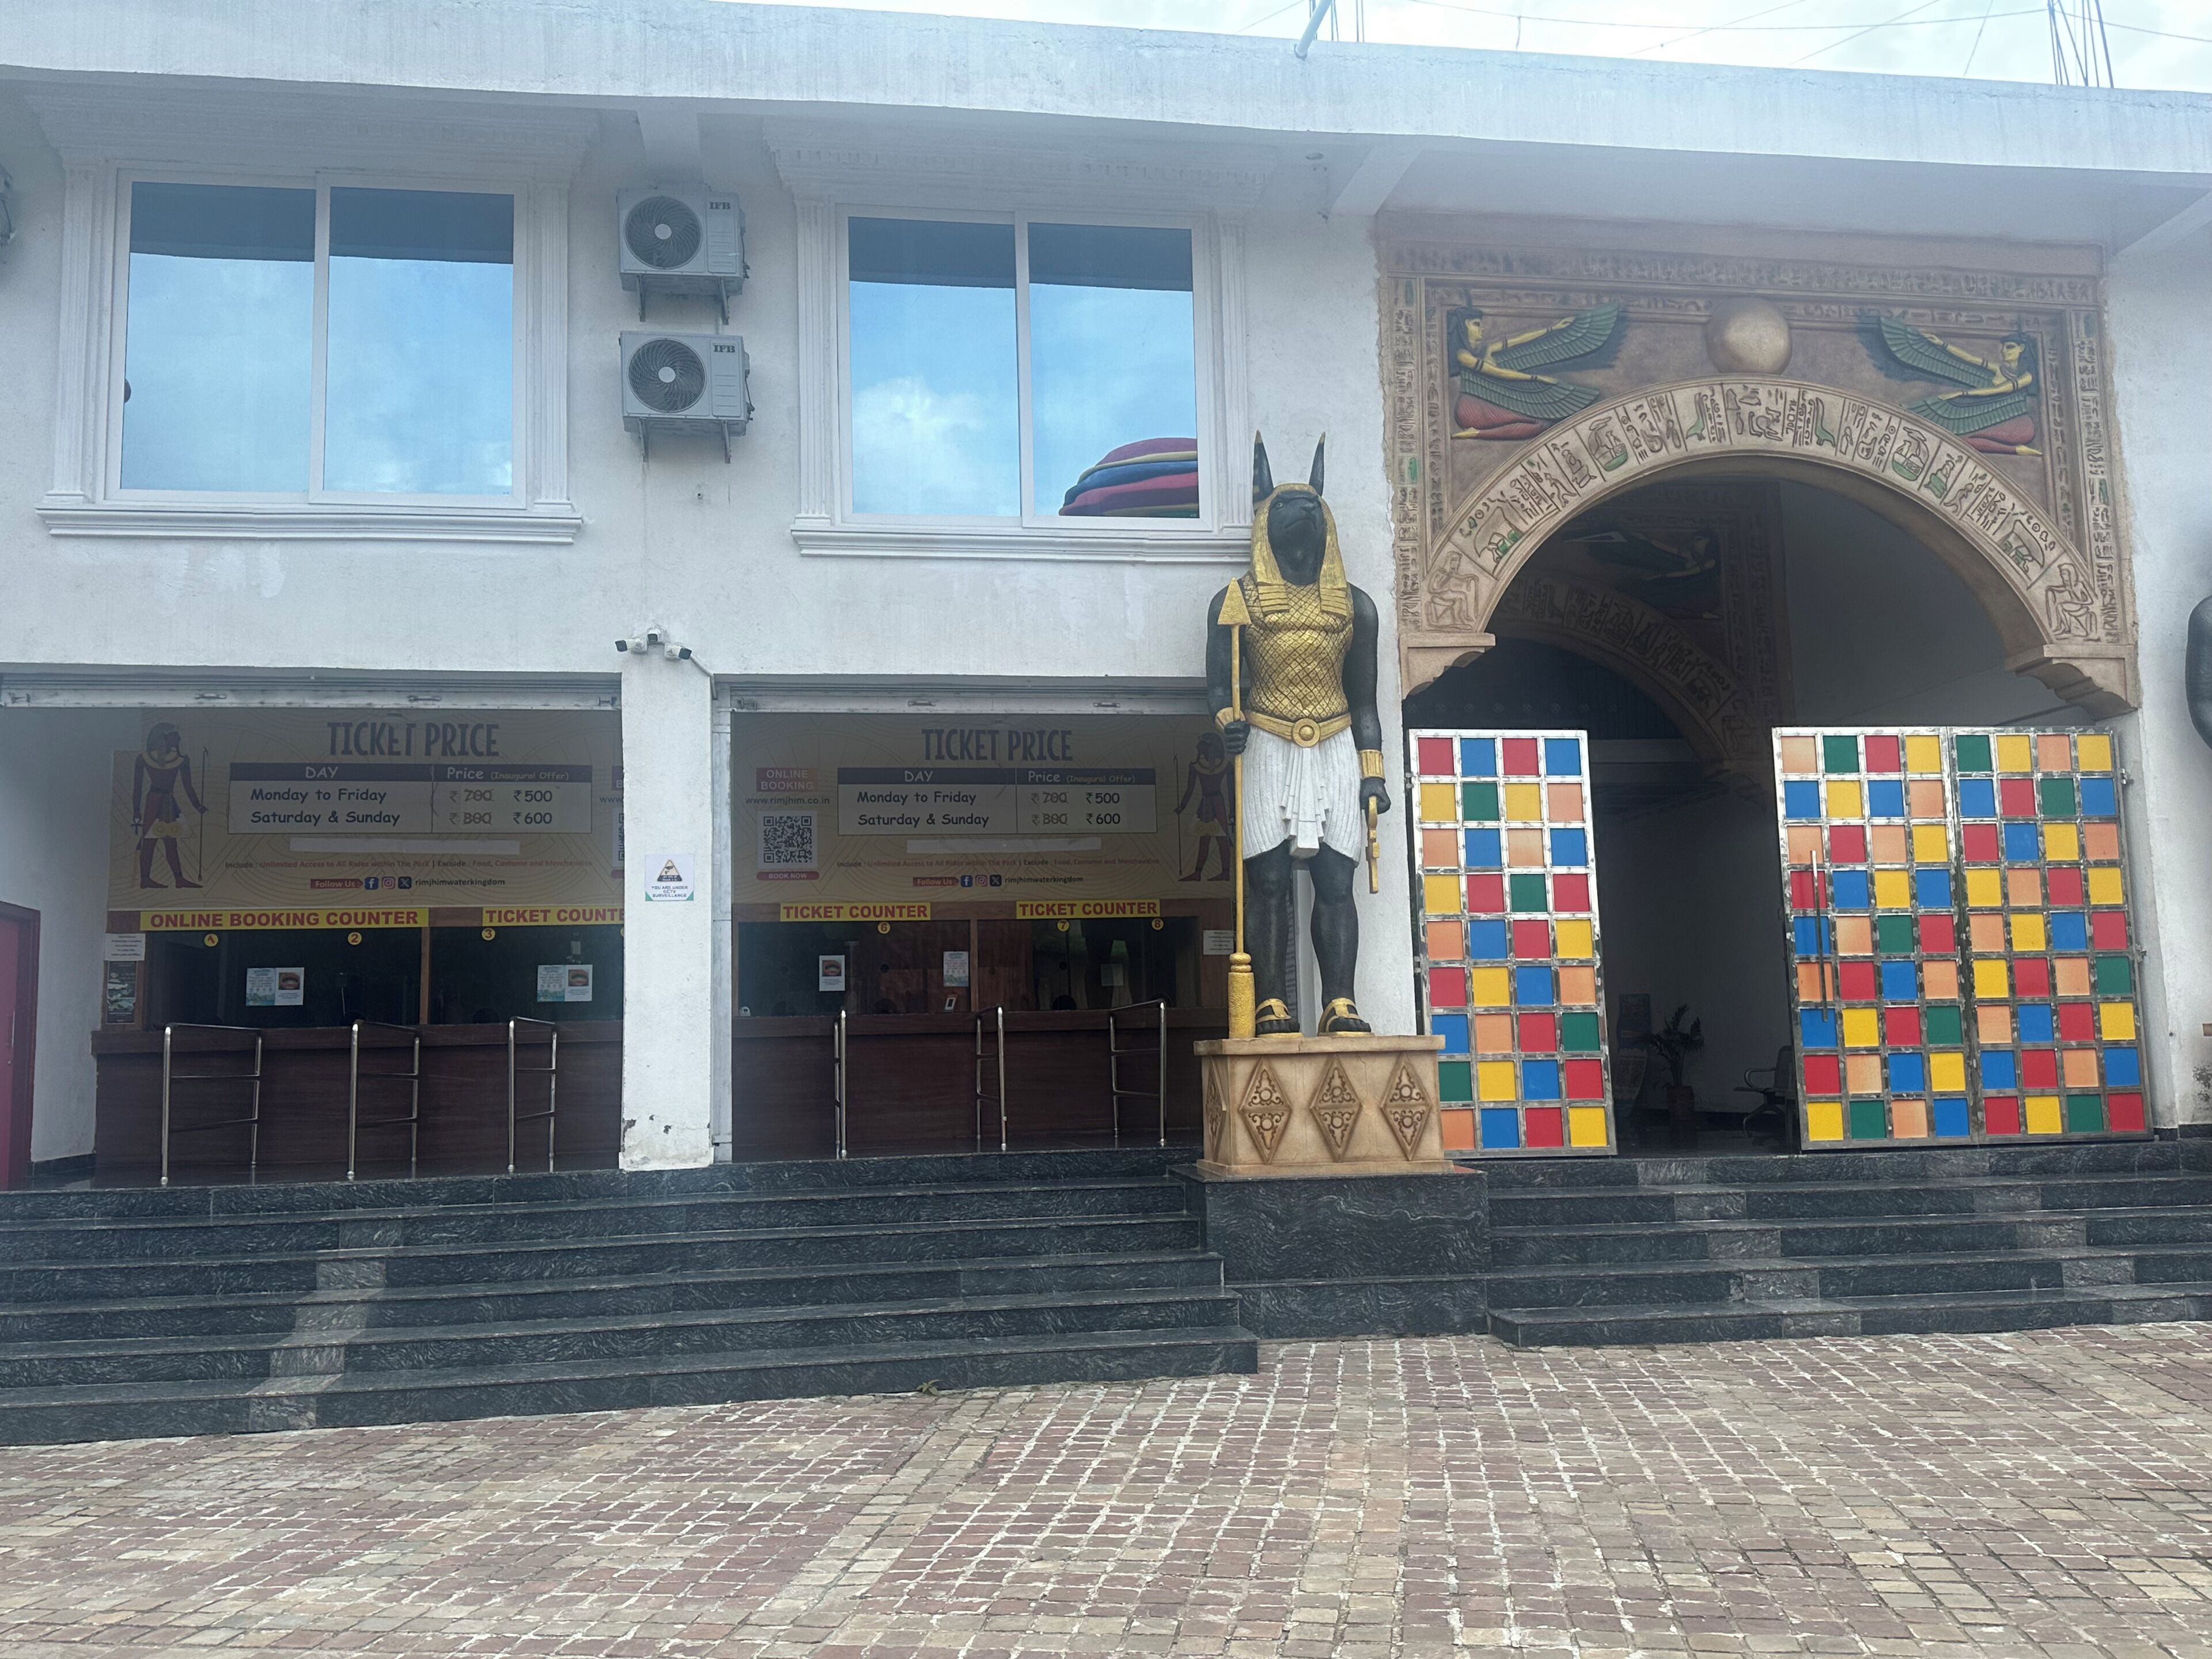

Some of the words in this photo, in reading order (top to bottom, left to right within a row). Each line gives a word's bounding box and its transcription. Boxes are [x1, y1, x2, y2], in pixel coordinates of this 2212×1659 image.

[709, 202, 731, 210] IFB
[713, 344, 736, 353] IFB
[327, 722, 416, 756] TICKET
[424, 722, 499, 757] PRICE
[921, 729, 999, 760] TICKET
[1007, 729, 1073, 761] PRICE
[305, 766, 339, 779] DAY
[446, 767, 484, 779] Price
[491, 771, 536, 781] (Inaugural
[539, 771, 569, 781] Offer)
[766, 770, 808, 778] ONLINE
[904, 770, 933, 782] DAY
[1028, 771, 1060, 783] Price
[1066, 775, 1106, 784] (Inaugural
[1109, 775, 1135, 783] Offer)
[761, 781, 813, 790] BOOKING
[251, 788, 309, 804] Monday
[315, 789, 331, 801] to
[338, 788, 387, 804] Friday
[745, 796, 830, 806] www.rimjhim.co.in
[857, 791, 908, 806] Monday
[914, 791, 927, 803] to
[934, 791, 976, 806] Friday
[251, 810, 321, 827] Saturday
[328, 810, 338, 823] &
[346, 810, 400, 827] Sunday
[858, 813, 921, 828] Saturday
[926, 813, 935, 825] &
[941, 813, 989, 827] Sunday
[415, 878, 505, 887] rimjhimwaterkingdom
[1005, 875, 1084, 885] rimjhimwaterkingdom
[783, 906, 843, 919] TICKET
[849, 905, 928, 918] COUNTER
[1019, 903, 1077, 916] TICKET
[1082, 902, 1157, 915] COUNTER
[150, 914, 223, 928] ONLINE
[230, 912, 320, 927] BOOKING
[326, 911, 418, 926] COUNTER
[485, 909, 551, 923] TICKET
[881, 923, 888, 933] 6
[1059, 921, 1066, 929] 7
[1154, 919, 1161, 928] 8
[351, 934, 358, 943] 2
[484, 929, 492, 938] 3
